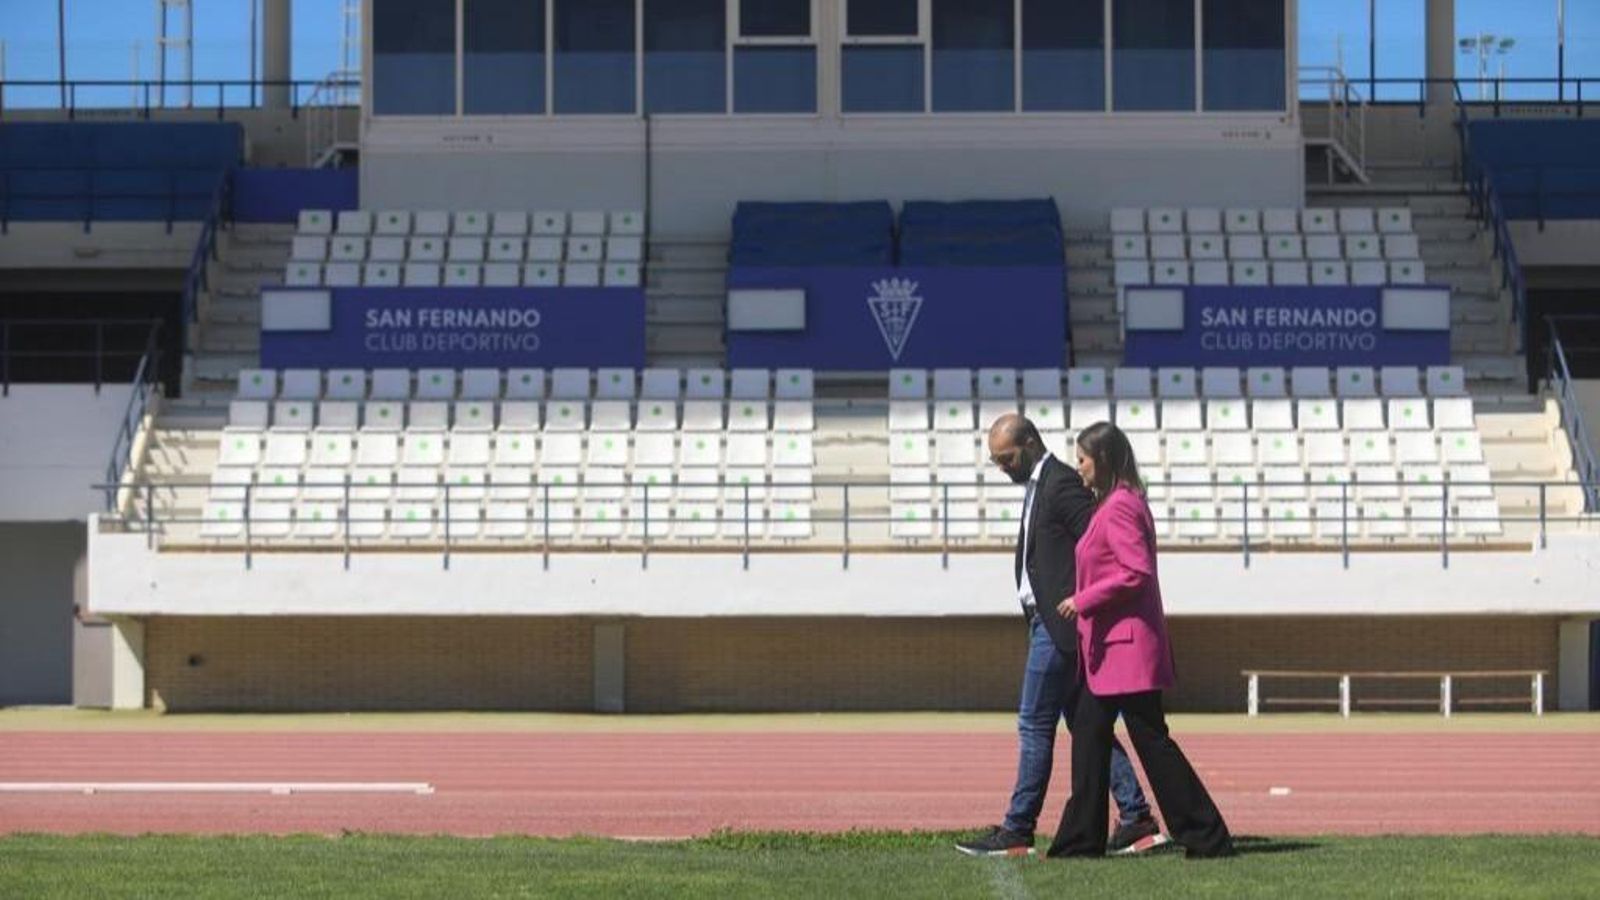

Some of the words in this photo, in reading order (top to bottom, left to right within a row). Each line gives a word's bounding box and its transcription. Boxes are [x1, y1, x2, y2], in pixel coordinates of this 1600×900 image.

[365, 308, 412, 329] SAN
[417, 308, 541, 328] FERNANDO
[1201, 307, 1247, 327] SAN
[1253, 307, 1377, 327] FERNANDO
[365, 332, 418, 352] CLUB
[422, 332, 540, 352] DEPORTIVO
[1201, 331, 1254, 351] CLUB
[1258, 331, 1376, 351] DEPORTIVO
